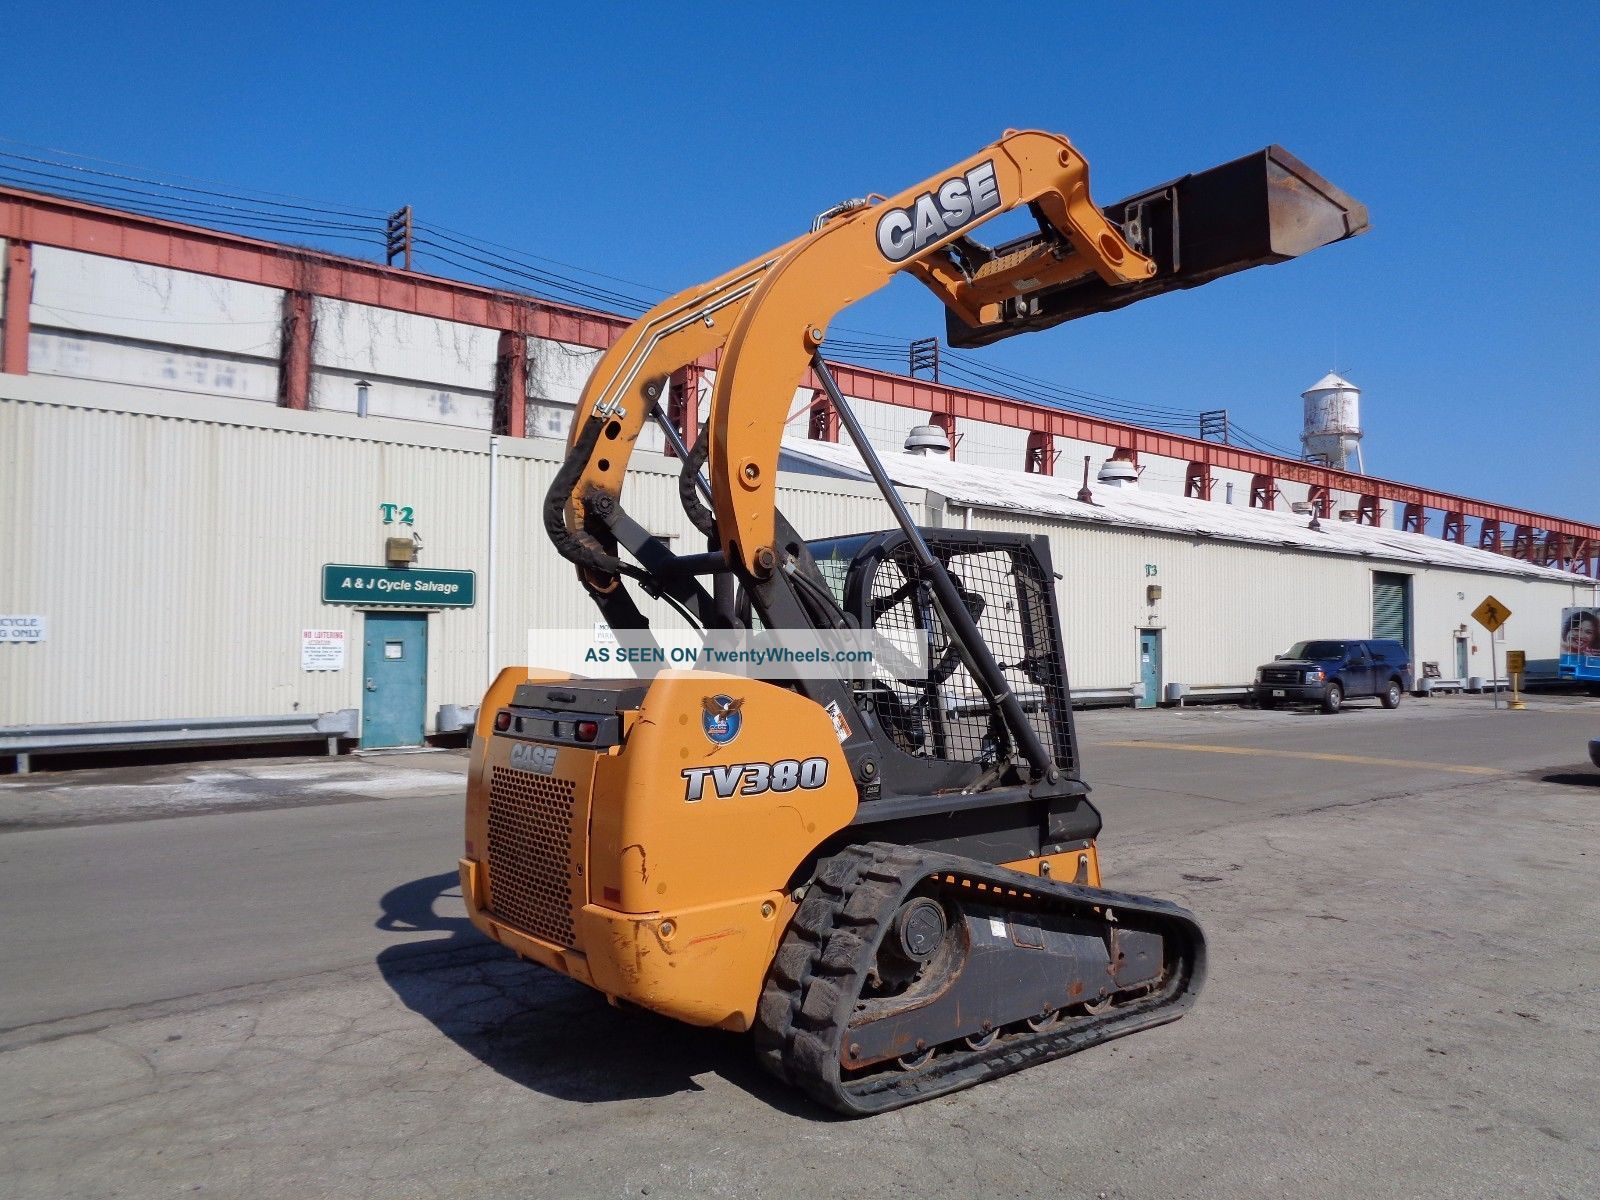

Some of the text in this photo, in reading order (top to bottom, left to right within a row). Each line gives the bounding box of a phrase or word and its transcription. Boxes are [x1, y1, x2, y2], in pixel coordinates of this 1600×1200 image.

[876, 159, 1001, 262] CASE
[380, 502, 415, 525] T2
[341, 577, 459, 595] A & J Cycle Salvage
[11, 629, 40, 637] ONLY
[303, 631, 343, 639] NO LOITERING
[511, 742, 558, 773] CASE
[681, 756, 828, 802] TV380
